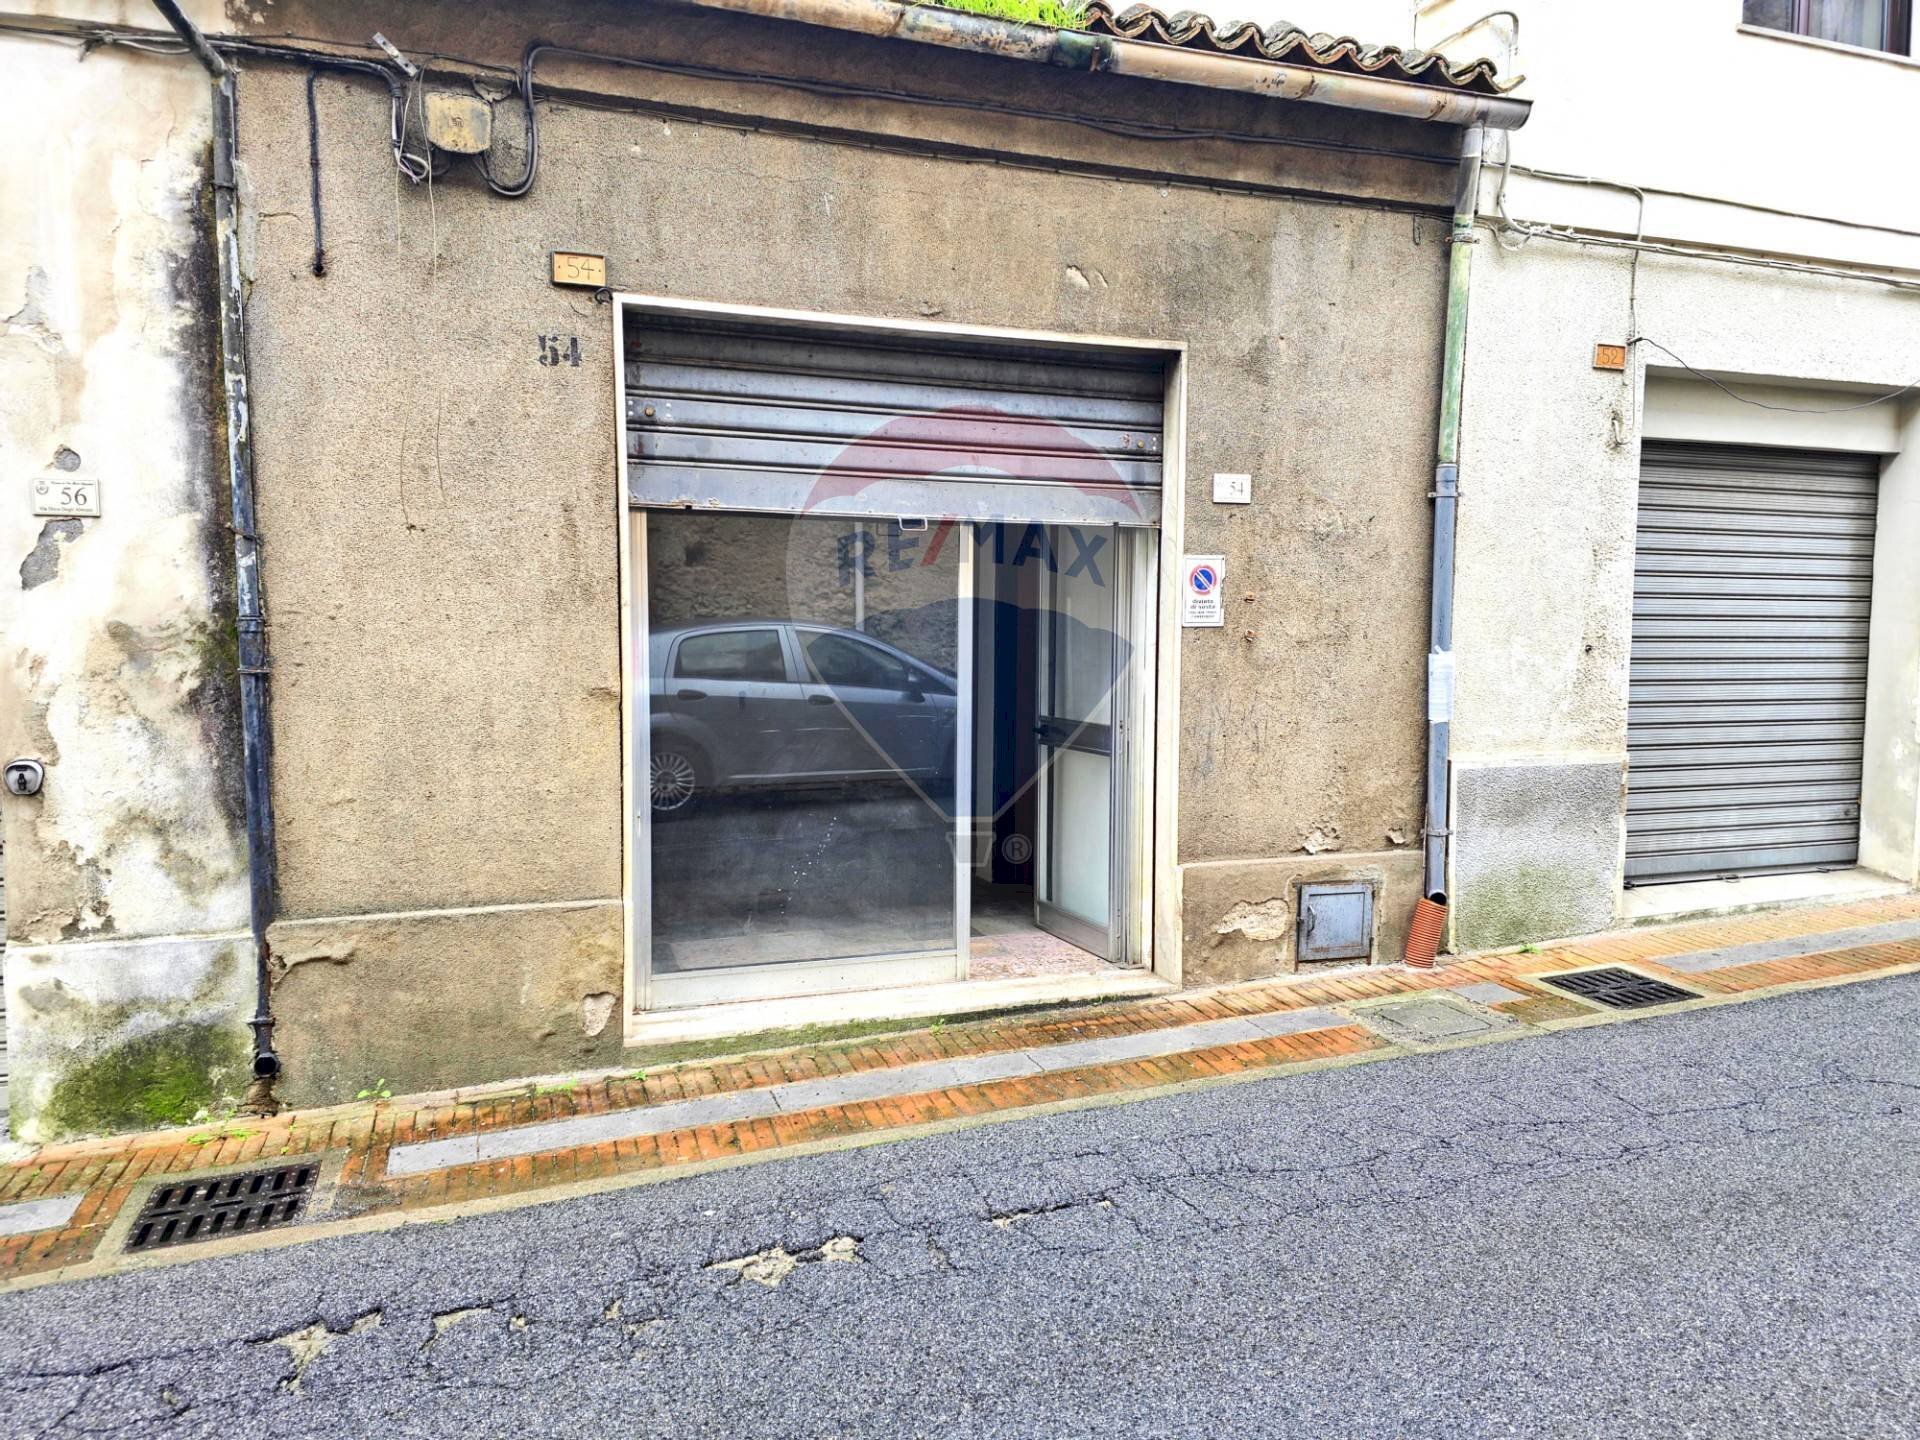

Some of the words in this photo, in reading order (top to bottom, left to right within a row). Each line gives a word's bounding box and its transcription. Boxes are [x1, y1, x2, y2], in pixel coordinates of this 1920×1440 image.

[567, 256, 595, 280] 54
[538, 334, 582, 367] 54
[1602, 347, 1620, 365] 52
[60, 486, 88, 506] 56
